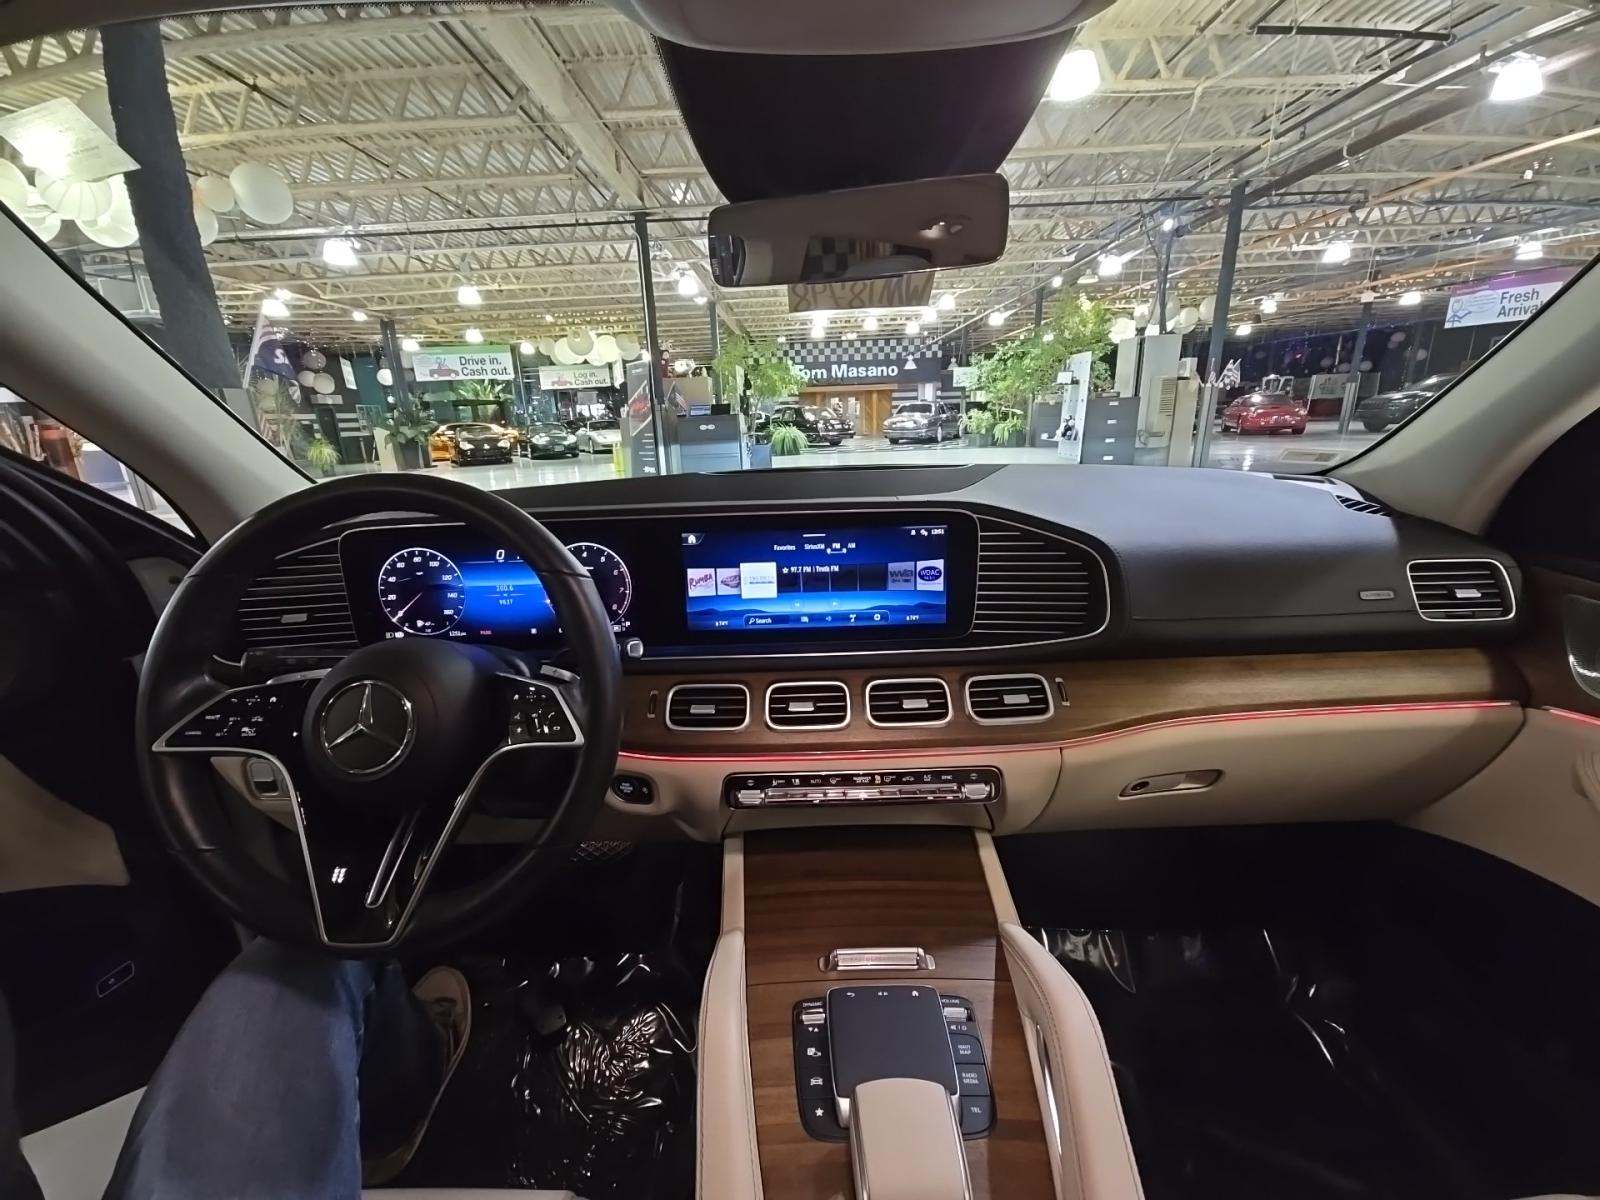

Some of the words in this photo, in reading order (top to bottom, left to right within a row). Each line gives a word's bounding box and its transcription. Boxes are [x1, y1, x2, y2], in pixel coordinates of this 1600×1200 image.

[1500, 288, 1540, 304] Fresh
[1497, 301, 1544, 318] Arriva
[459, 356, 486, 366] Drive
[488, 356, 502, 366] in.
[461, 366, 488, 376] Cash
[491, 366, 511, 376] out.
[574, 371, 588, 380] Log
[832, 364, 899, 378] Masano
[574, 378, 592, 386] Cash
[496, 550, 505, 559] 0
